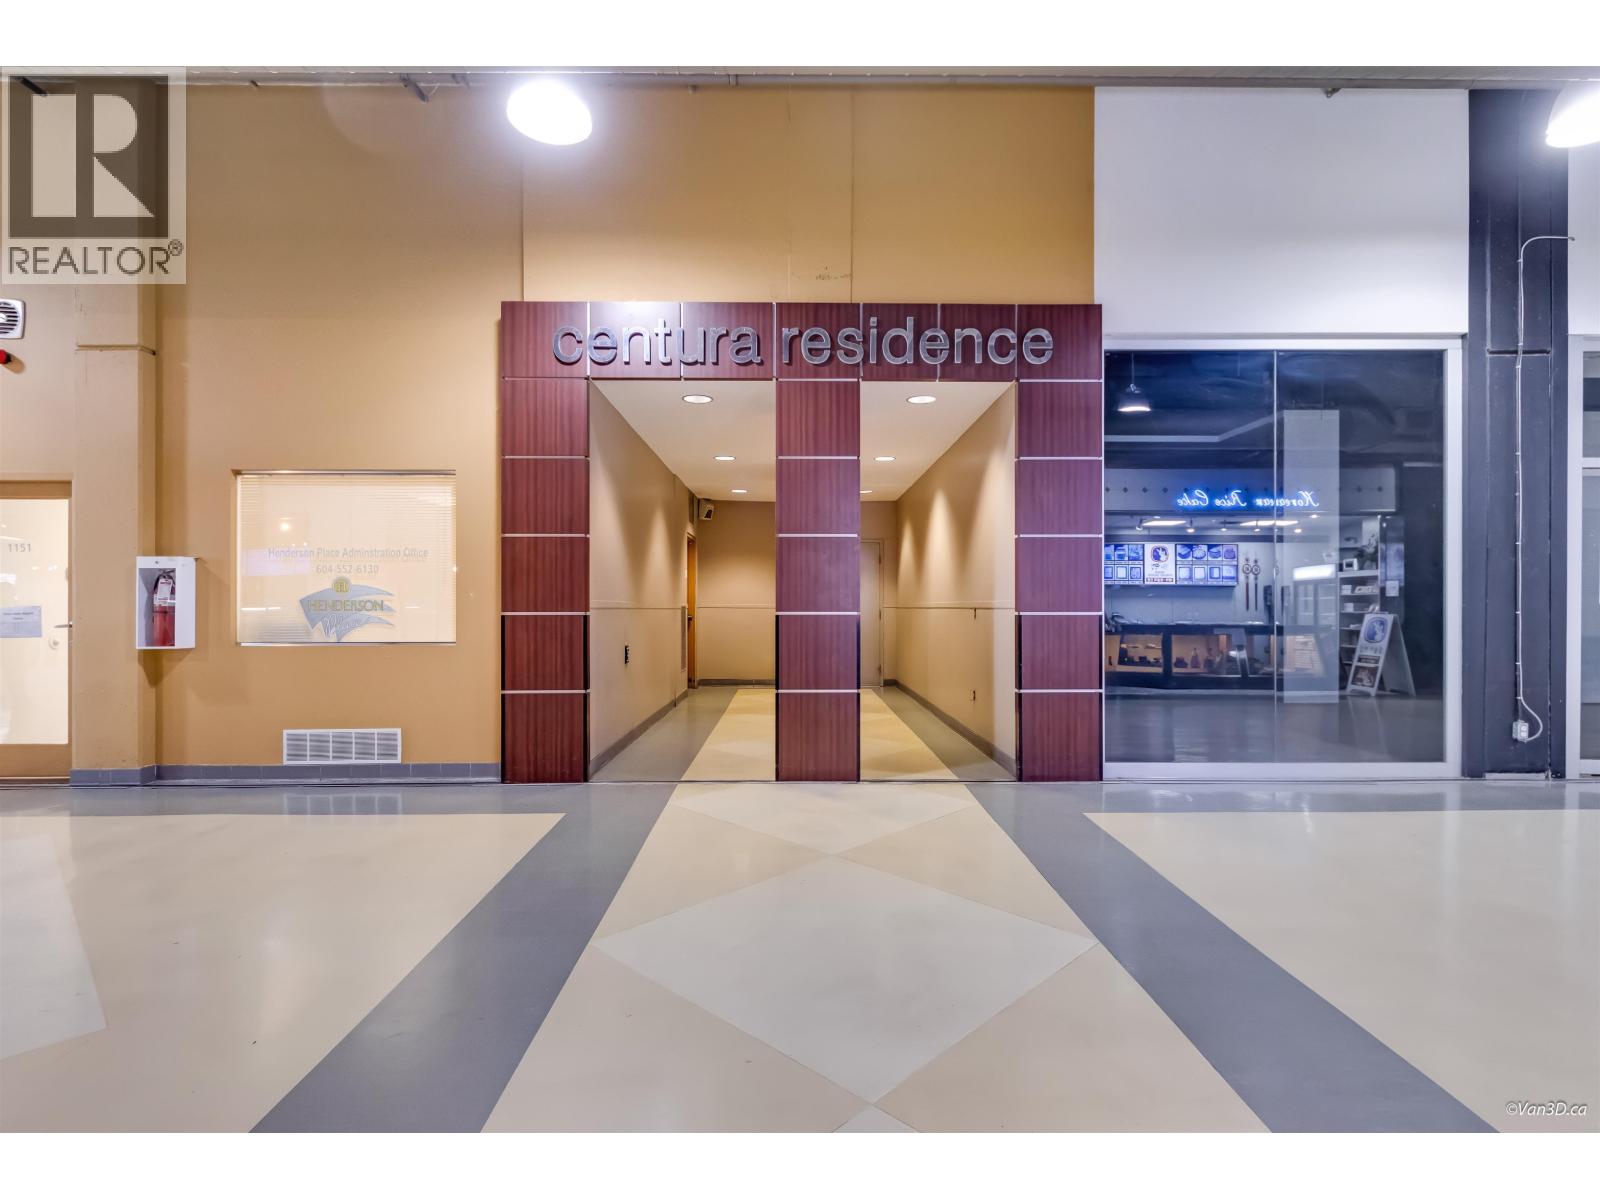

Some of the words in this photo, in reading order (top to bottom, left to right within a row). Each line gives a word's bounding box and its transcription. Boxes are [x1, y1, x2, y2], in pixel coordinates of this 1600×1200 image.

[551, 318, 762, 366] centura
[780, 315, 1055, 367] residence
[7, 543, 32, 553] 1151
[268, 547, 314, 558] Henderson
[316, 547, 340, 558] Place
[403, 547, 428, 558] Office
[307, 599, 384, 612] HENDERSON
